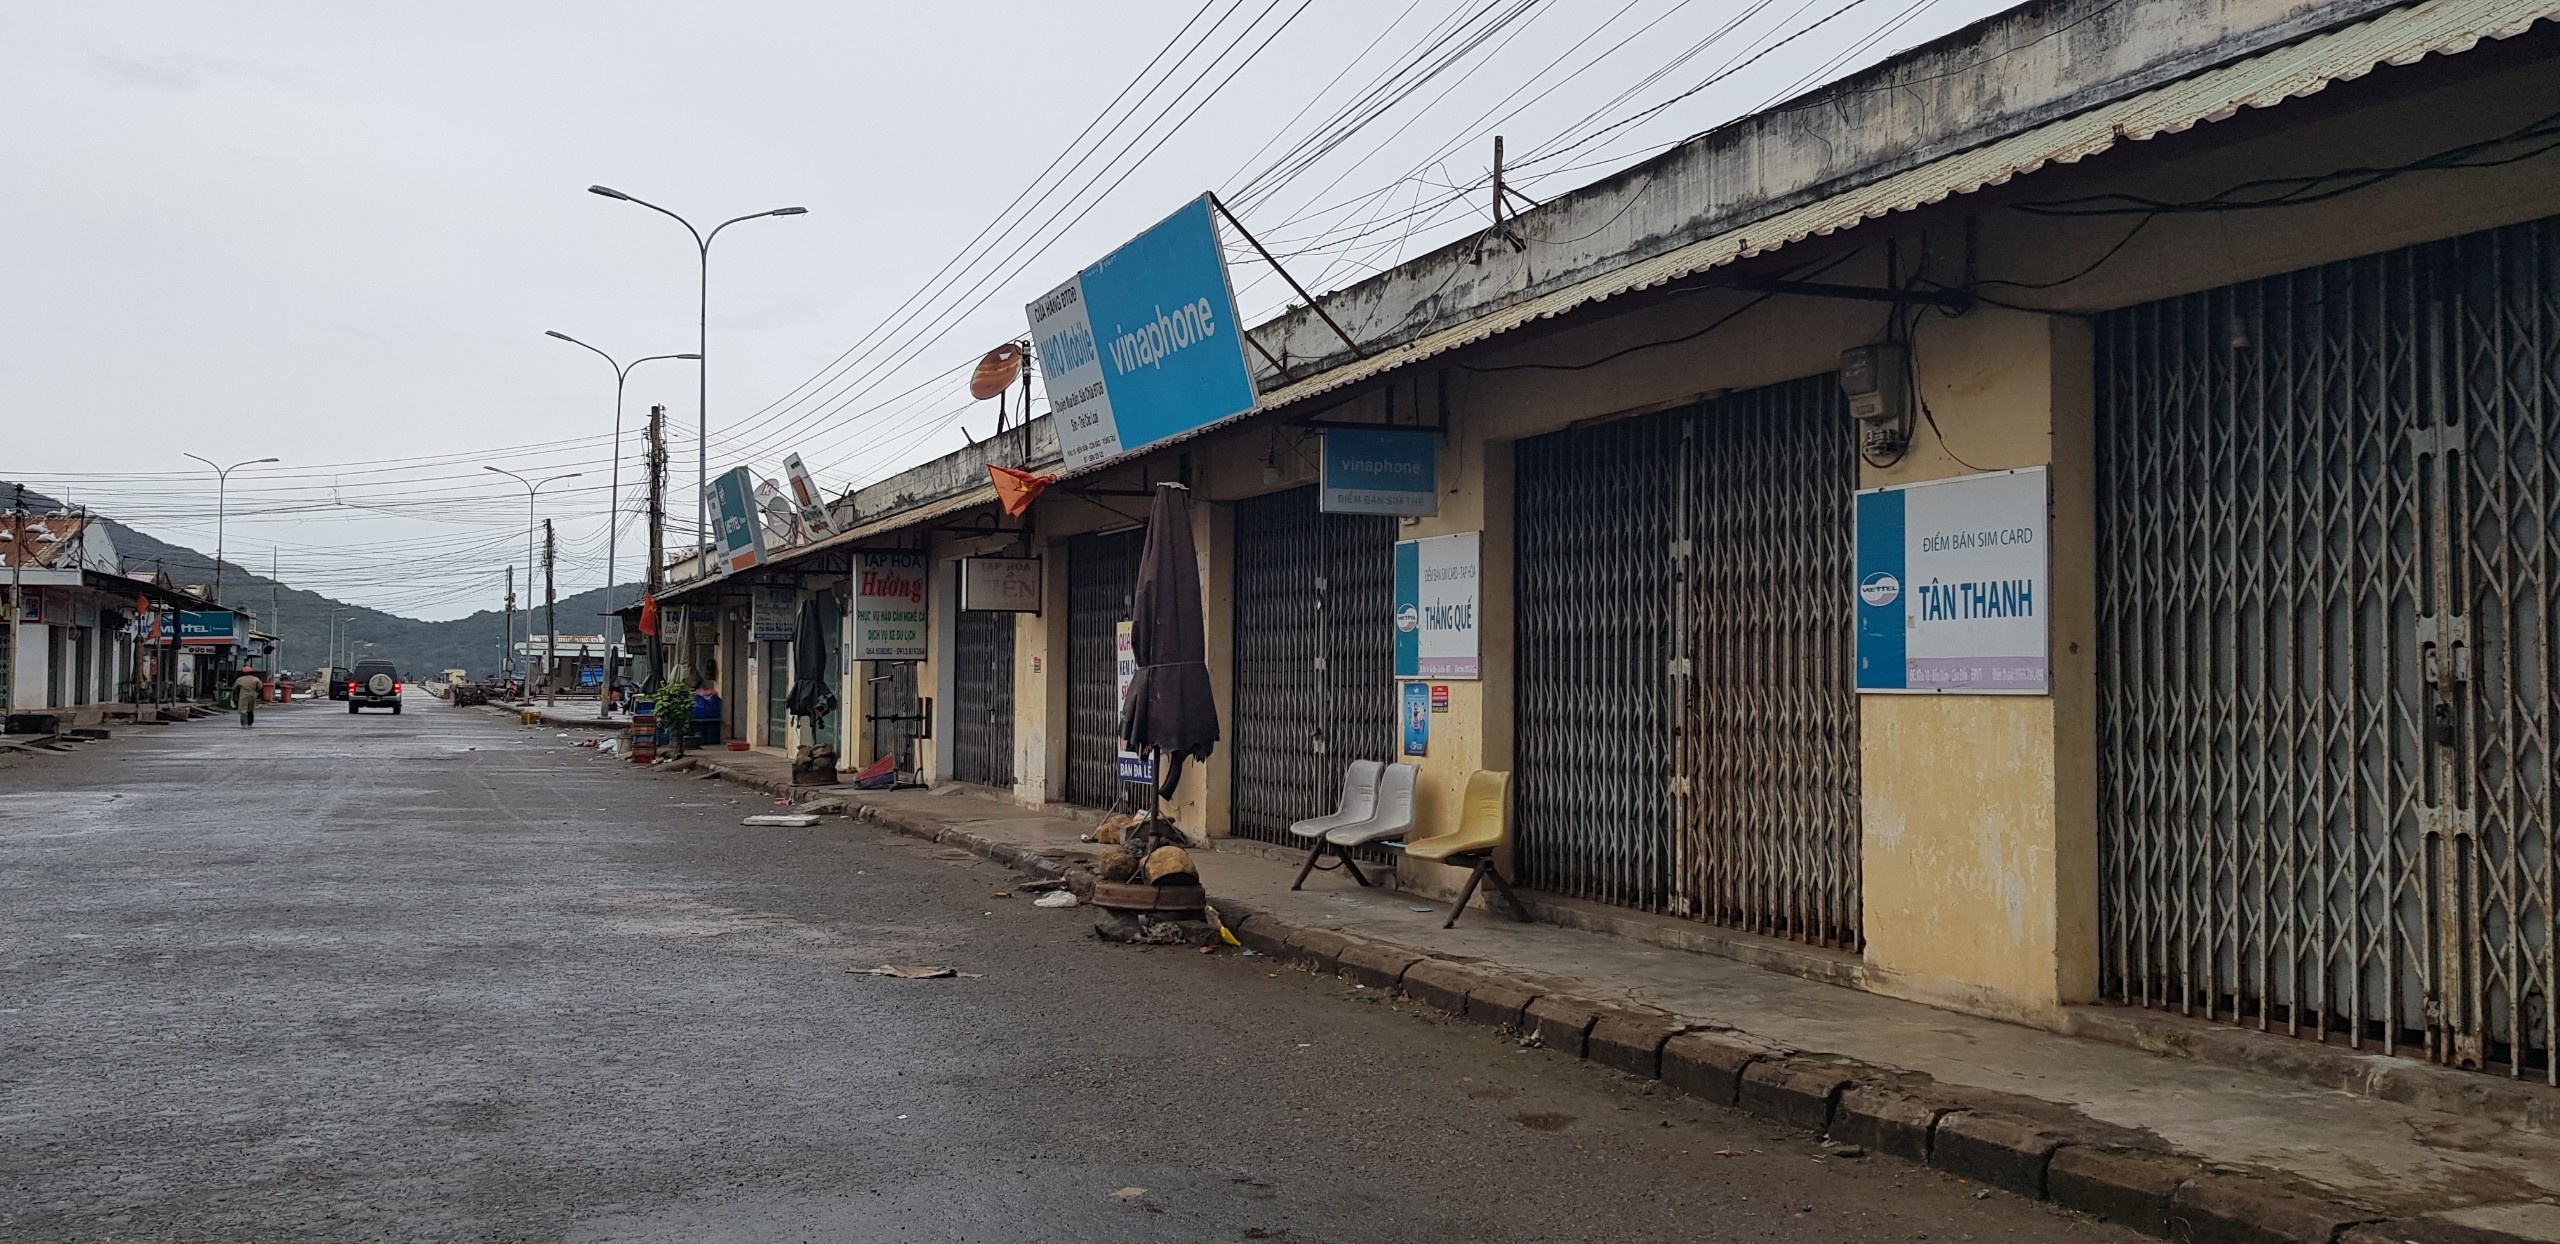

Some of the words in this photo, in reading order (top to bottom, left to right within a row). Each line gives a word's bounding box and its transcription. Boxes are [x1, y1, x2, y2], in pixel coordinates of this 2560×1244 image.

[1045, 295, 1062, 317] HÀNG
[1059, 320, 1095, 371] Mobile
[1108, 297, 1215, 376] vinaphone
[1341, 456, 1421, 476] vinaphone
[1337, 490, 1361, 504] ĐIỂM
[1364, 493, 1384, 505] BÁN
[1386, 496, 1403, 506] SIM
[1922, 531, 1950, 552] ĐIỂM
[1952, 530, 1975, 550] BÁN
[1977, 531, 1998, 548] SIM
[2000, 527, 2033, 546] CARD
[863, 554, 888, 570] TẠP
[1861, 585, 1898, 593] VIETTEL
[1918, 577, 1957, 622] TÂN
[1960, 578, 2033, 620] THANH
[872, 610, 880, 624] VỤ
[1454, 594, 1473, 632] QUẾ
[881, 629, 888, 644] VỤ
[889, 629, 896, 641] XE
[896, 629, 904, 641] DU
[1119, 660, 1130, 676] KEM
[1120, 759, 1133, 777] BÁN
